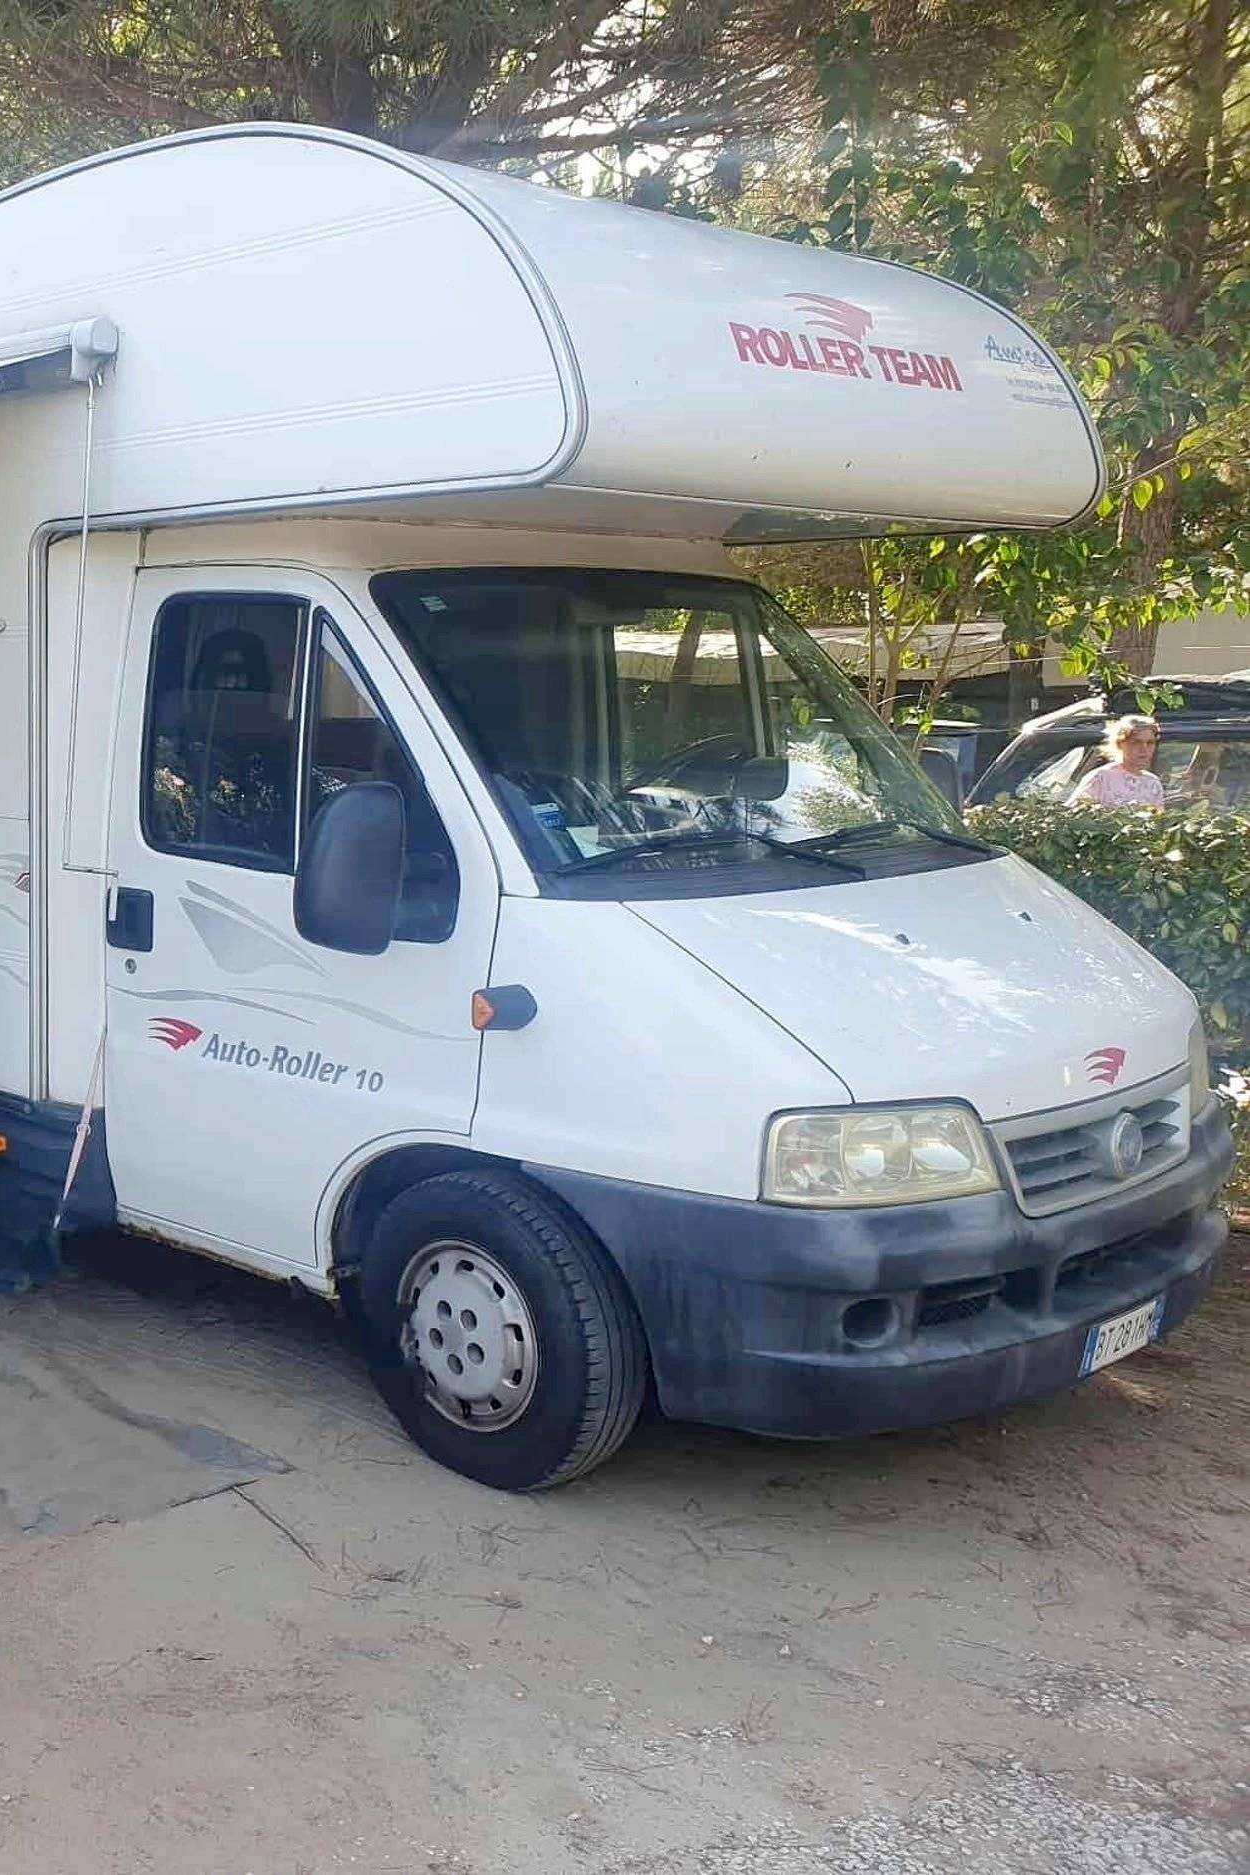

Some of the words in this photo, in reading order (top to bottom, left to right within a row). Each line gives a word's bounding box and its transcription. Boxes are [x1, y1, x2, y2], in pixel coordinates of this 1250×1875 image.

[729, 322, 872, 379] ROLLER
[868, 345, 963, 391] TEAM
[201, 1034, 348, 1085] Auto-Roller
[355, 1069, 384, 1093] 10
